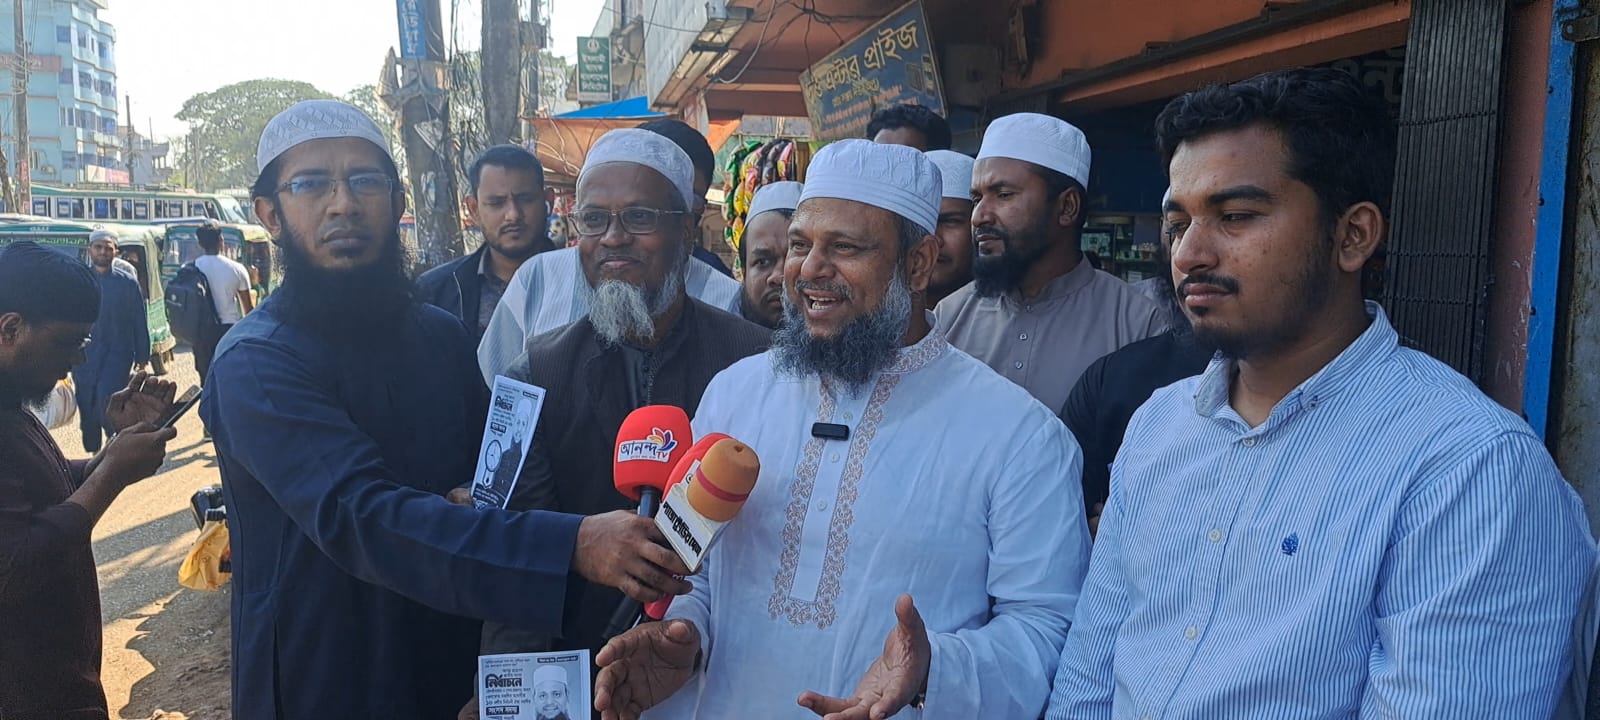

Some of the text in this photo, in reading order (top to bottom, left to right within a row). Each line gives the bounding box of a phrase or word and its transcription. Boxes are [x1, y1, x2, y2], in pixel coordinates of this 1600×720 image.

[864, 20, 918, 69] প্রাইজ
[620, 440, 657, 456] আনন্দ
[656, 452, 668, 460] TV
[485, 673, 522, 688] নির্বাচনে
